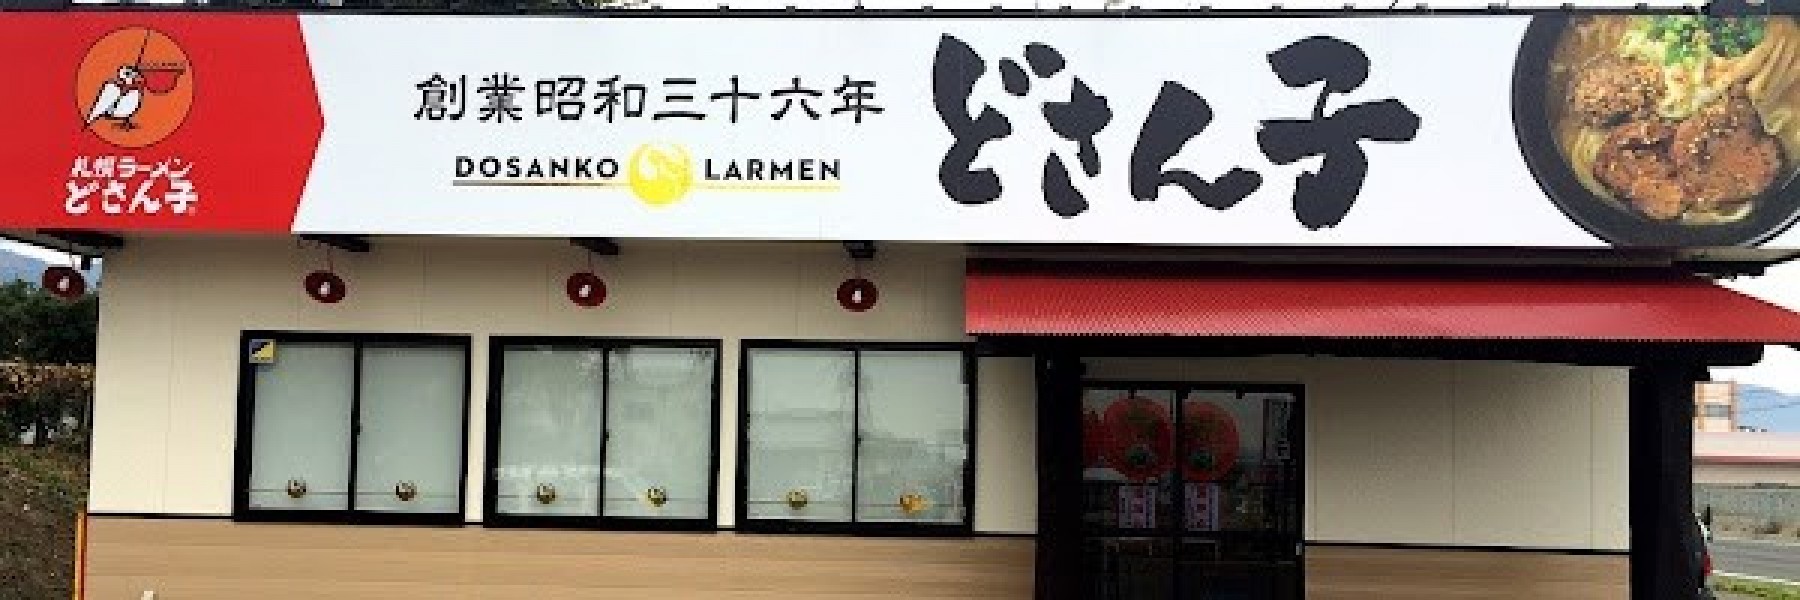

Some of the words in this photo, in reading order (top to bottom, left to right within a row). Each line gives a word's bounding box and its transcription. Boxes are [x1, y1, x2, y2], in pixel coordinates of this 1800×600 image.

[413, 72, 886, 124] 創業昭和三十六年
[932, 32, 1423, 232] どさん子
[455, 155, 619, 178] DOSANKO
[704, 158, 841, 181] LARMEN
[65, 178, 199, 214] どさん子
